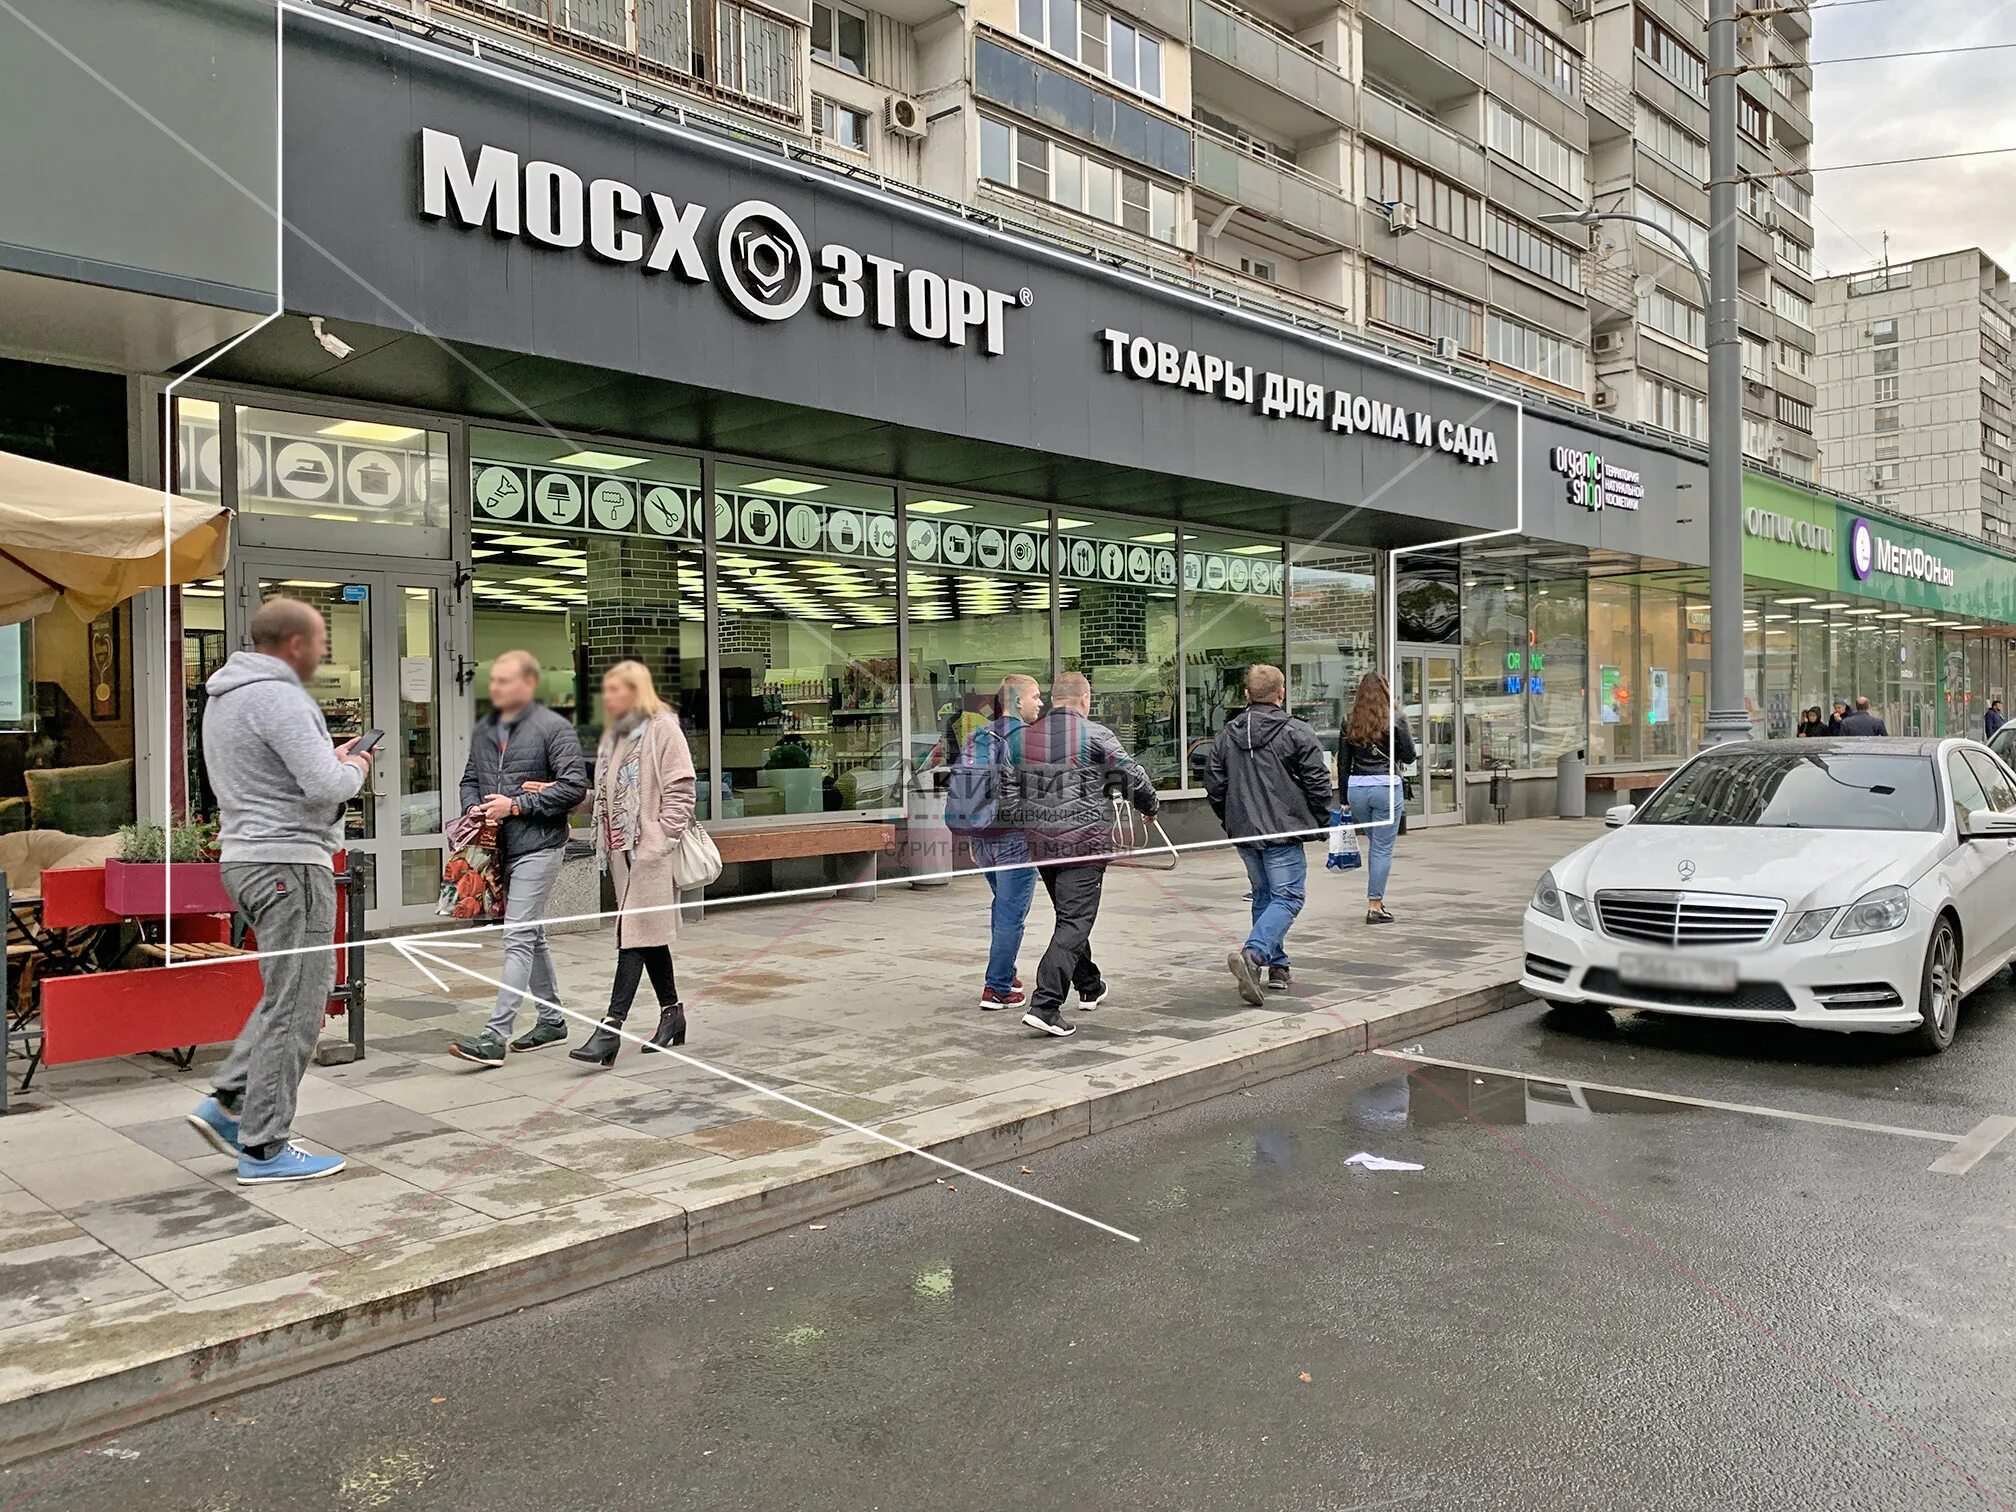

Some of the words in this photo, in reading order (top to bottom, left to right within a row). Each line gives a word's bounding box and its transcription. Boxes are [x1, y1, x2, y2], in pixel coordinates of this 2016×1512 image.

[1104, 328, 1254, 404] ТОВАРЫ
[1263, 372, 1325, 421] ДЛЯ
[1331, 390, 1410, 442] ДОМА
[1414, 412, 1432, 448] И
[1439, 419, 1499, 466] САДА
[1556, 446, 1601, 480] organic
[1573, 476, 1601, 511] shop
